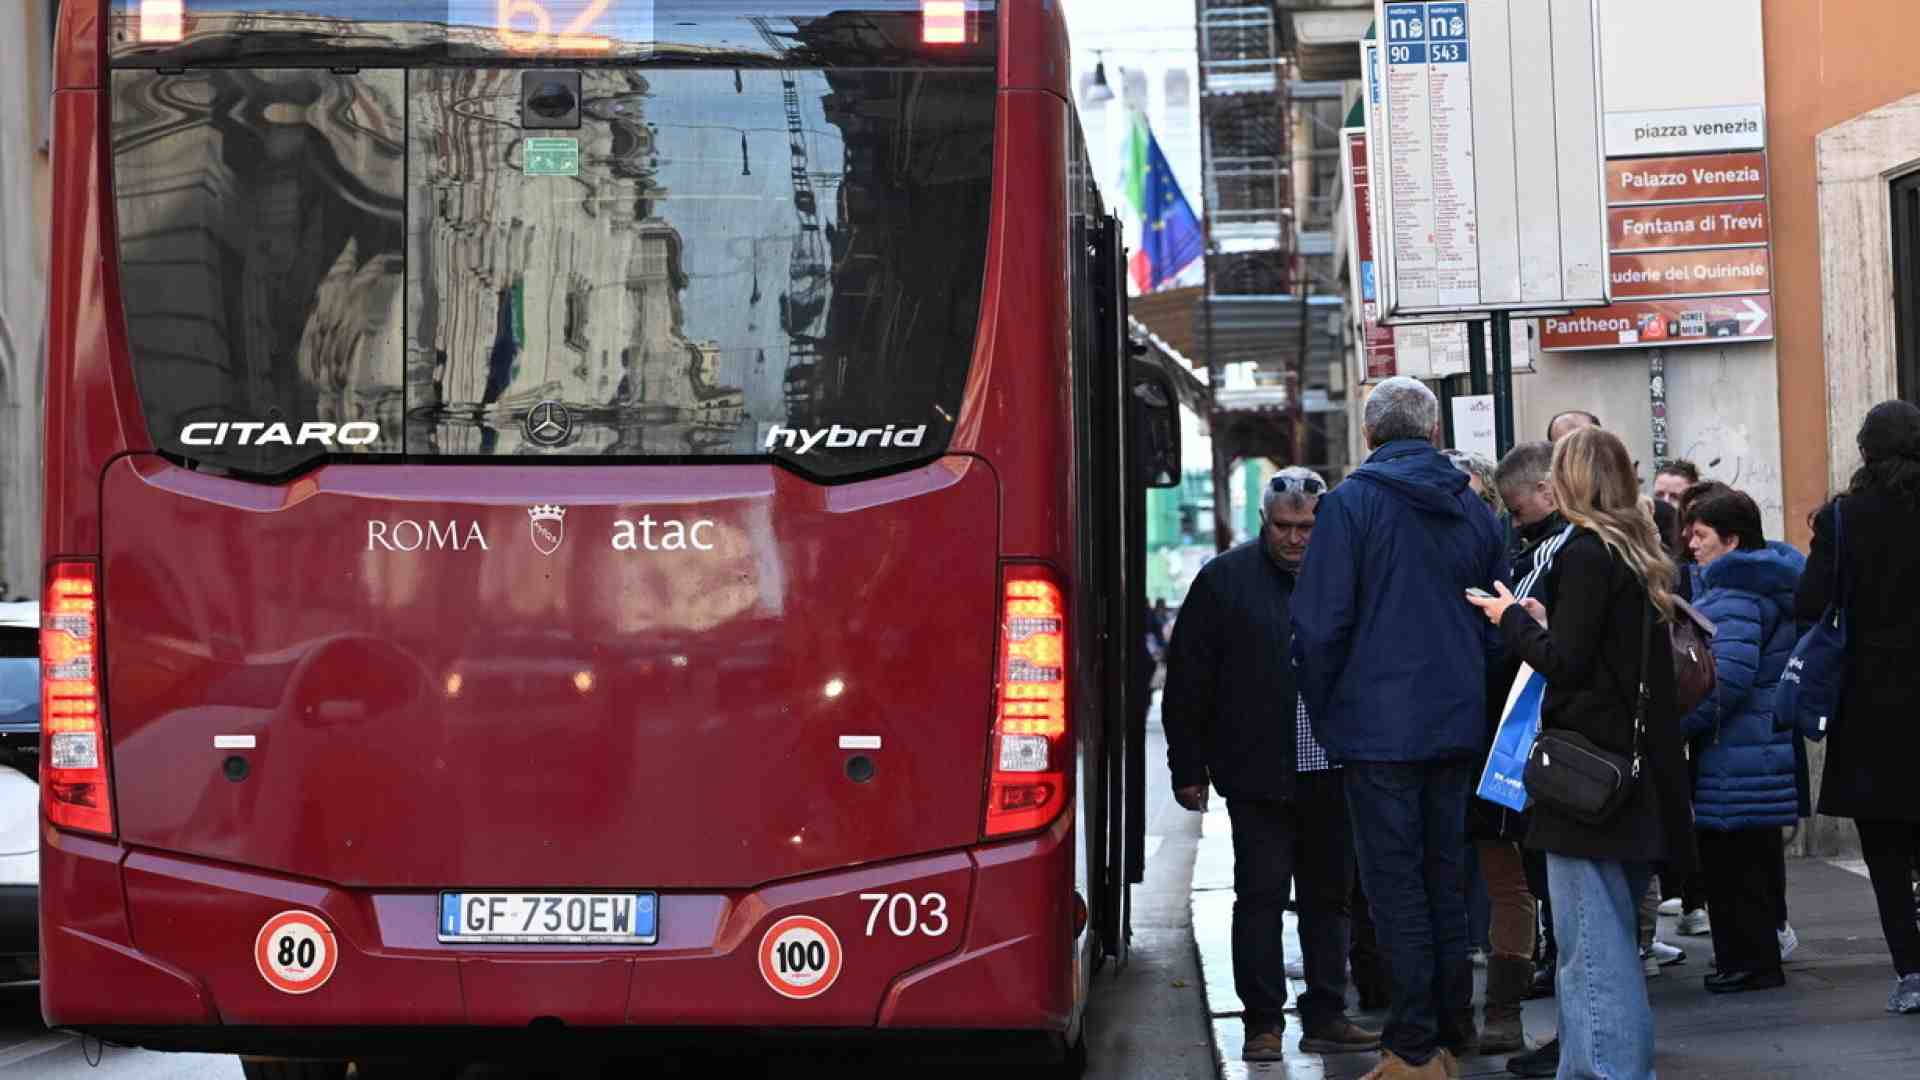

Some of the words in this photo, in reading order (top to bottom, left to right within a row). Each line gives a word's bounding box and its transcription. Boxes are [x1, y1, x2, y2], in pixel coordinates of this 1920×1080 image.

[1391, 46, 1410, 63] 90
[1431, 44, 1459, 61] 543
[1634, 123, 1688, 141] piazza
[1693, 118, 1758, 136] venezia
[1621, 171, 1687, 188] Palazzo
[1691, 166, 1760, 184] Venezia
[1622, 218, 1695, 235] Fontana
[1700, 215, 1716, 231] di
[1720, 212, 1763, 230] Trevi
[1611, 267, 1661, 283] uderie
[1665, 265, 1690, 281] del
[1693, 263, 1766, 279] Quirinale
[1545, 316, 1631, 335] Pantheon
[180, 422, 380, 446] CITARO
[764, 423, 927, 455] hybrid
[366, 519, 489, 551] ROMA
[611, 513, 715, 551] atac
[466, 897, 508, 931] GF
[522, 897, 631, 932] 730EW
[859, 892, 949, 937] 703
[277, 935, 316, 968] 80
[775, 940, 826, 973] 100
